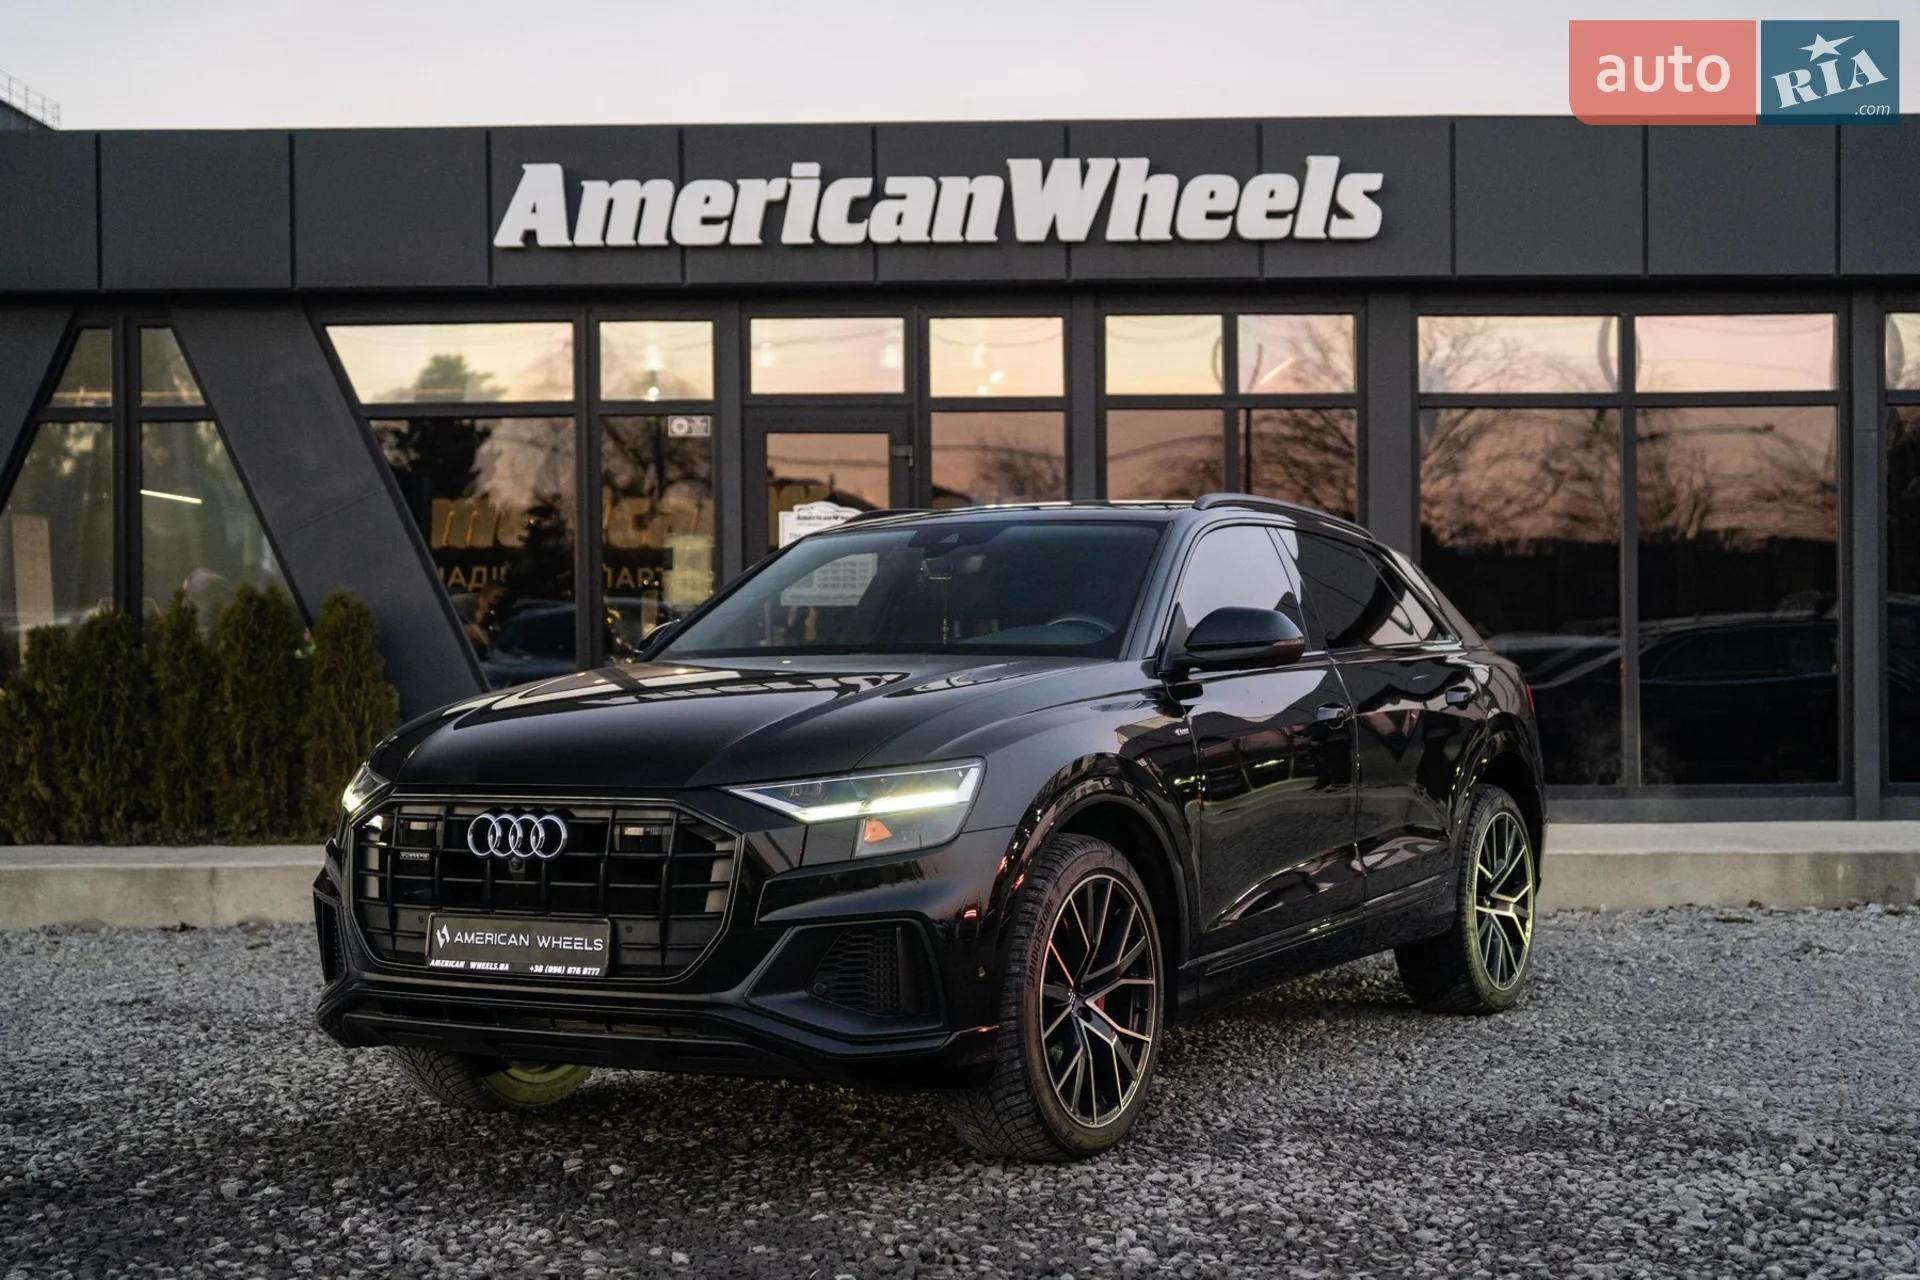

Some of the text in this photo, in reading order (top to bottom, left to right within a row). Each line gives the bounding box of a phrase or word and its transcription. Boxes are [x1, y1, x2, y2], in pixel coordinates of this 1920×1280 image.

[493, 154, 1384, 248] AmericanWheels
[453, 931, 604, 951] AMERICAN WHEELS
[429, 959, 466, 968] AMERICAN
